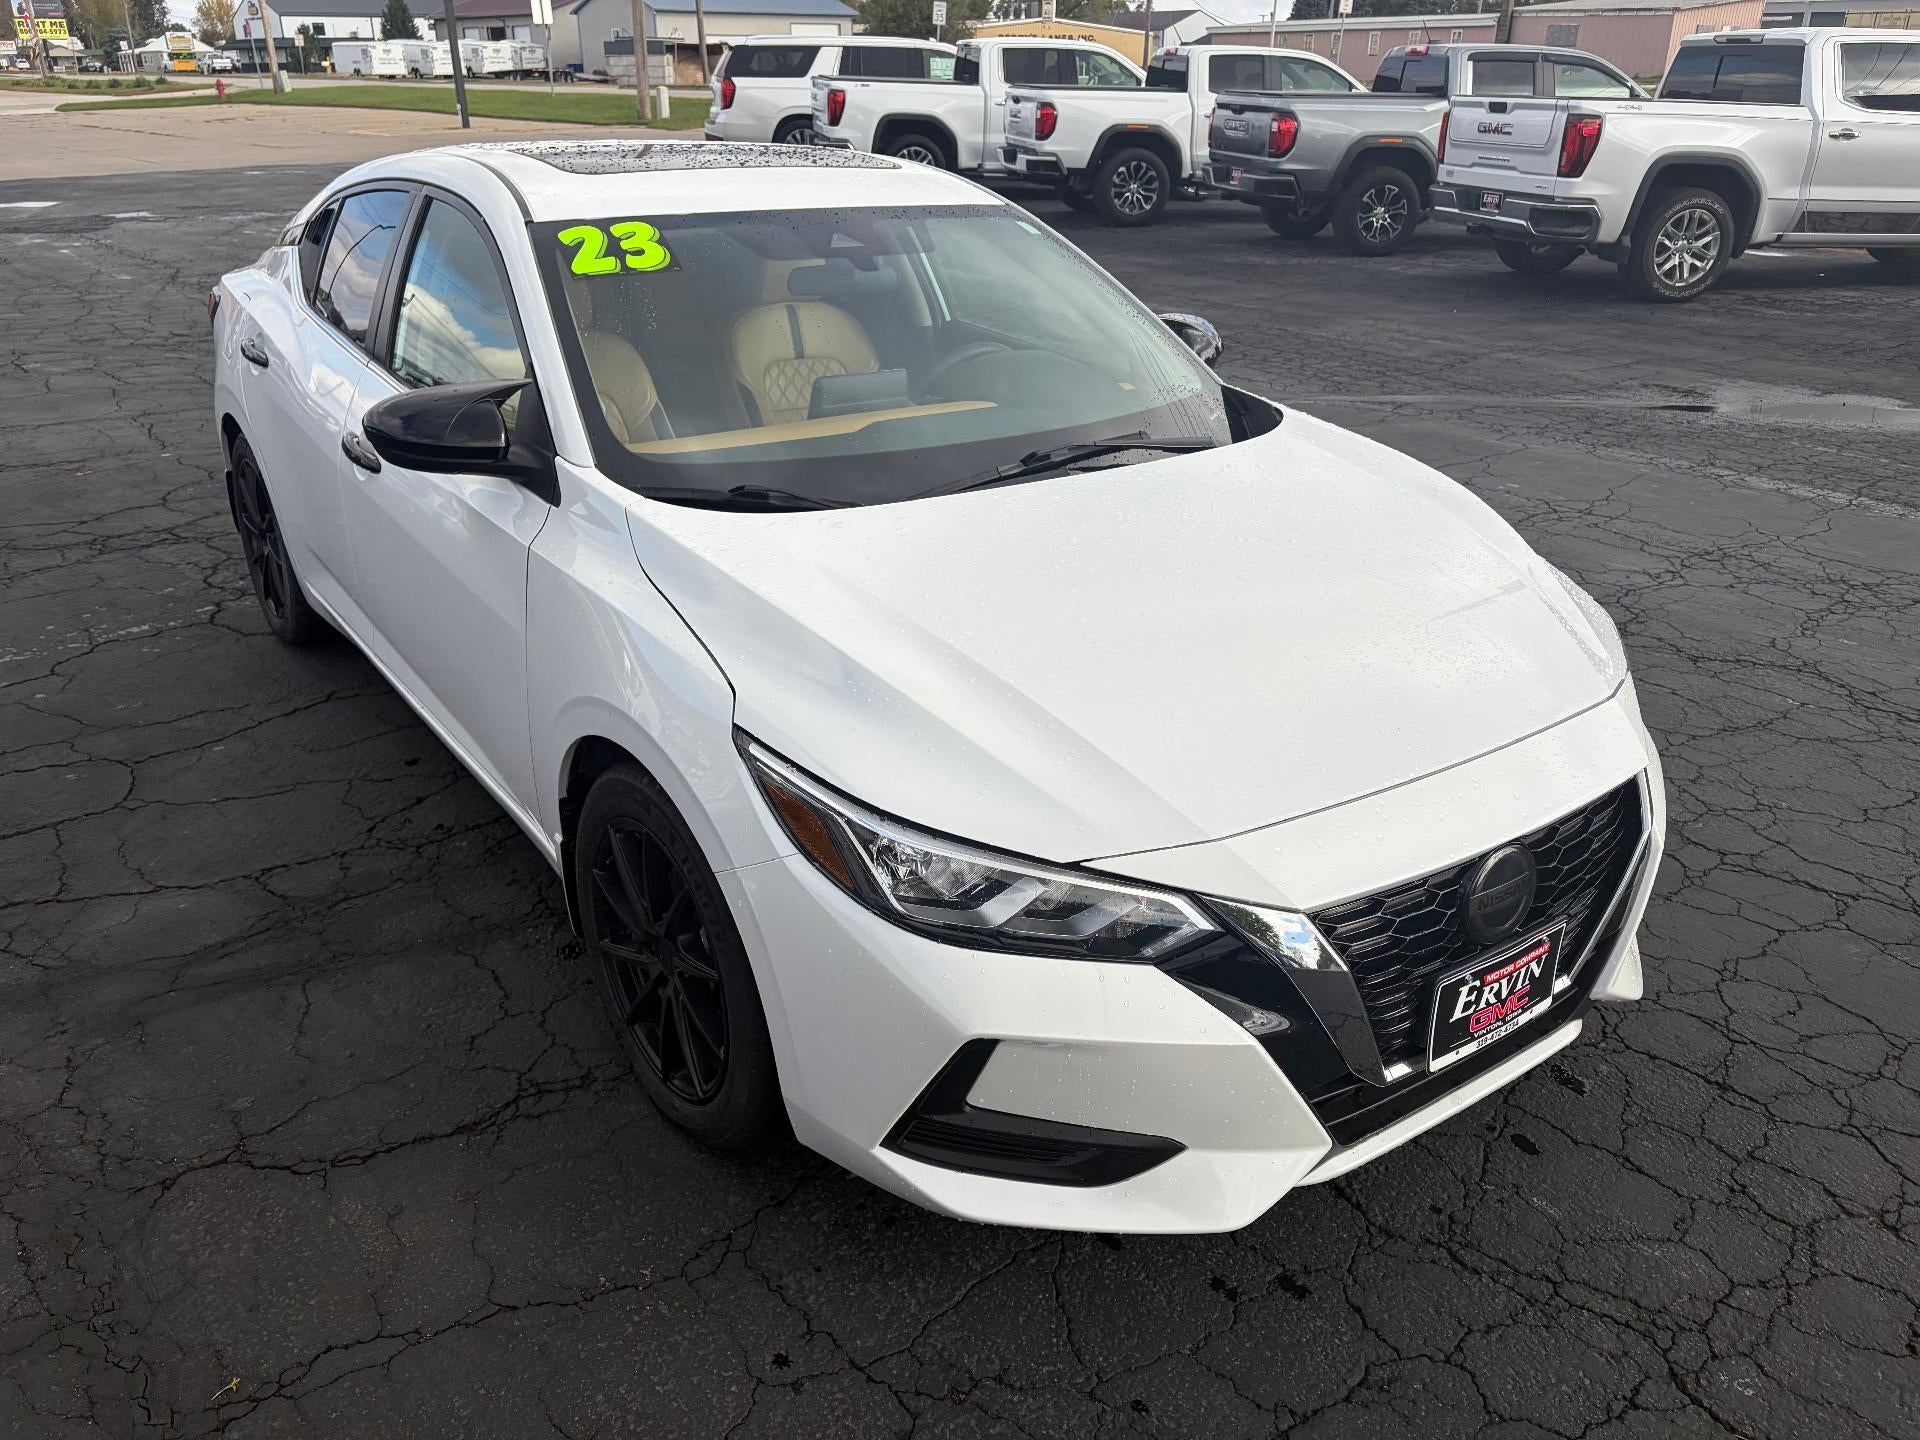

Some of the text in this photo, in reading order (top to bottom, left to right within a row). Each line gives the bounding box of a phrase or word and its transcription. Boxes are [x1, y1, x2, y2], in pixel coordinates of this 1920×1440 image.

[935, 13, 945, 22] 35
[1478, 122, 1513, 135] GMC
[557, 220, 672, 276] 23
[1486, 943, 1551, 983] MOTOR COMPANY
[1449, 953, 1548, 1023] ERVIN
[1469, 984, 1531, 1033] GMC
